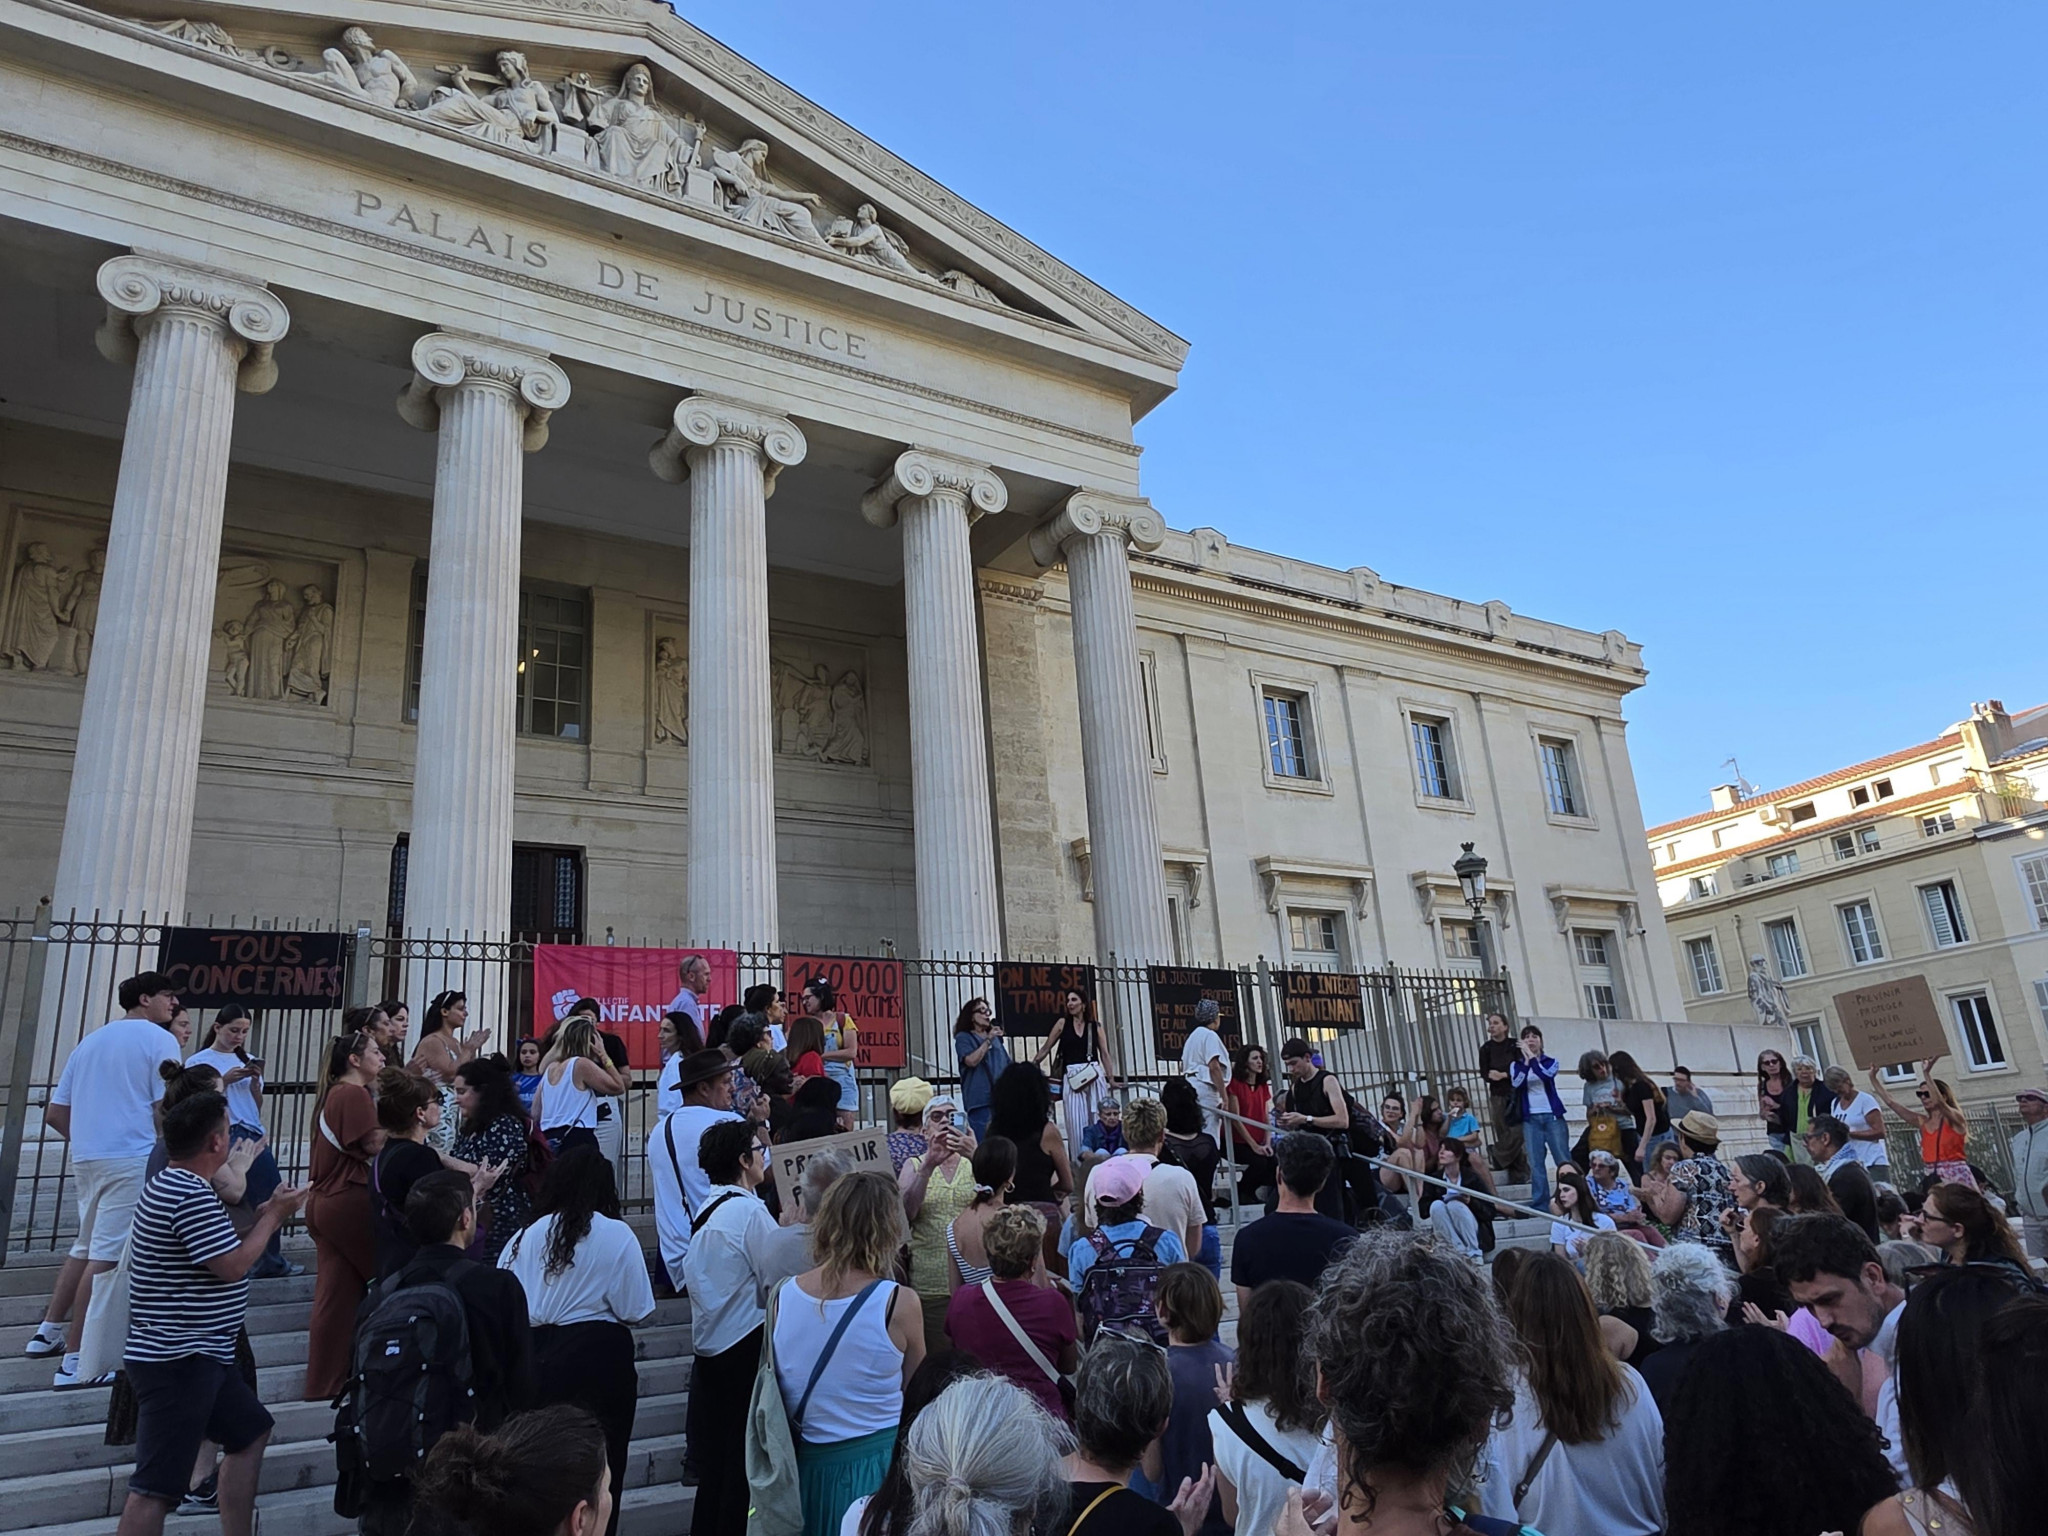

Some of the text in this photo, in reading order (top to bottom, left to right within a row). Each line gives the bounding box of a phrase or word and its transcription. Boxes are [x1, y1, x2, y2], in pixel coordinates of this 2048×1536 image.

[353, 190, 868, 361] PALAIS DE JUSTICE
[210, 934, 303, 965] TOUS
[166, 957, 342, 997] CONCERNÉS
[849, 962, 898, 995] 000
[1000, 966, 1085, 991] ON NE SE
[1155, 970, 1204, 986] LA JUSTICE
[1288, 975, 1312, 994] LOI
[788, 992, 902, 1018] ENTS VICTIMES
[1285, 997, 1361, 1022] MAINTENANT
[857, 1032, 900, 1047] XUELLES
